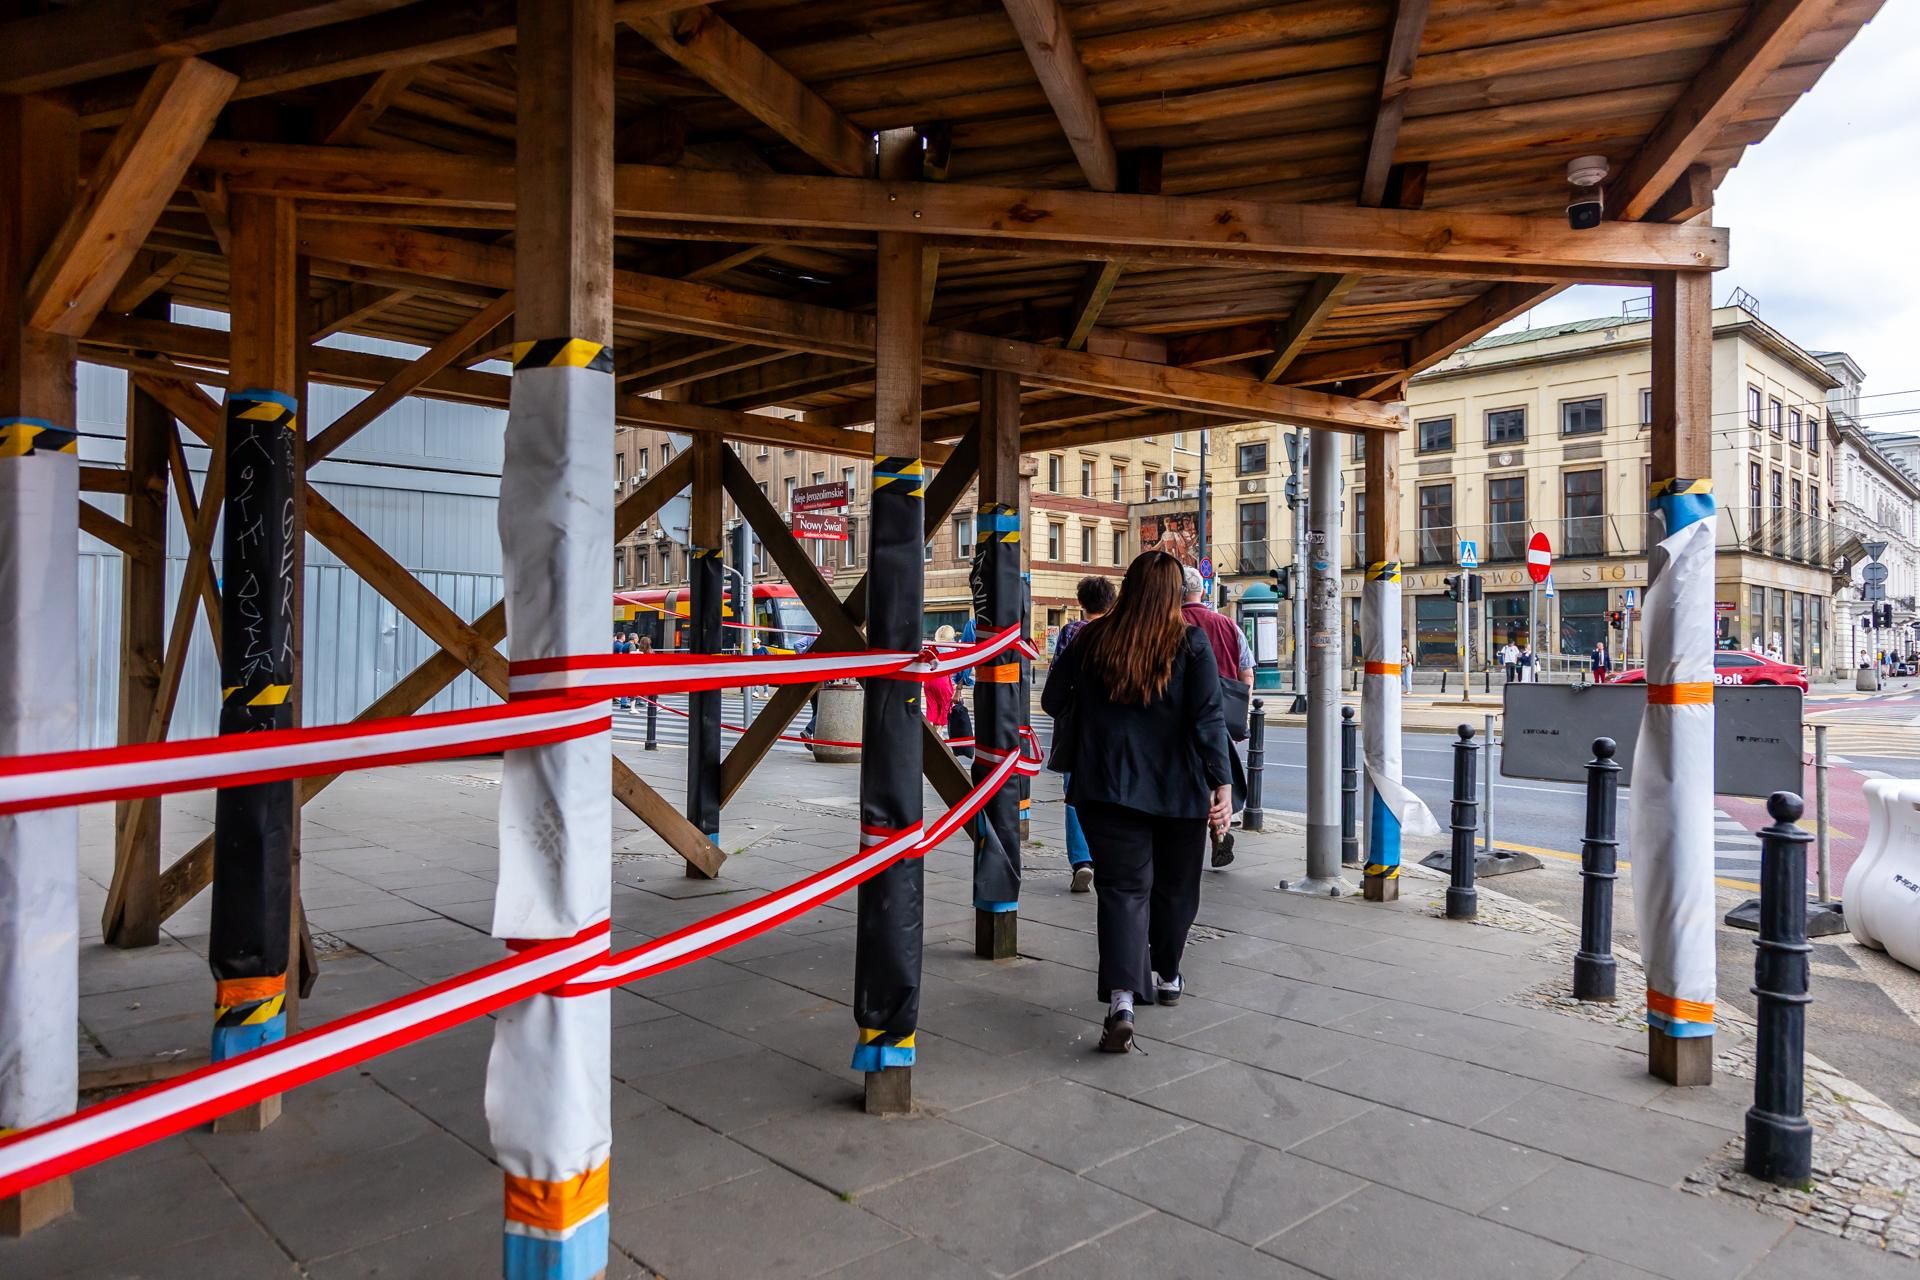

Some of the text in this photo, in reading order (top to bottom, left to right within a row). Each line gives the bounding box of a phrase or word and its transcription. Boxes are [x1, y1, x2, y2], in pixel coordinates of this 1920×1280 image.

[806, 487, 844, 503] Jerozolimskie
[800, 519, 823, 533] Nowy
[824, 518, 842, 532] Świat
[1480, 571, 1524, 585] SWO
[1582, 564, 1643, 581] STOL
[1714, 673, 1743, 685] Bolt
